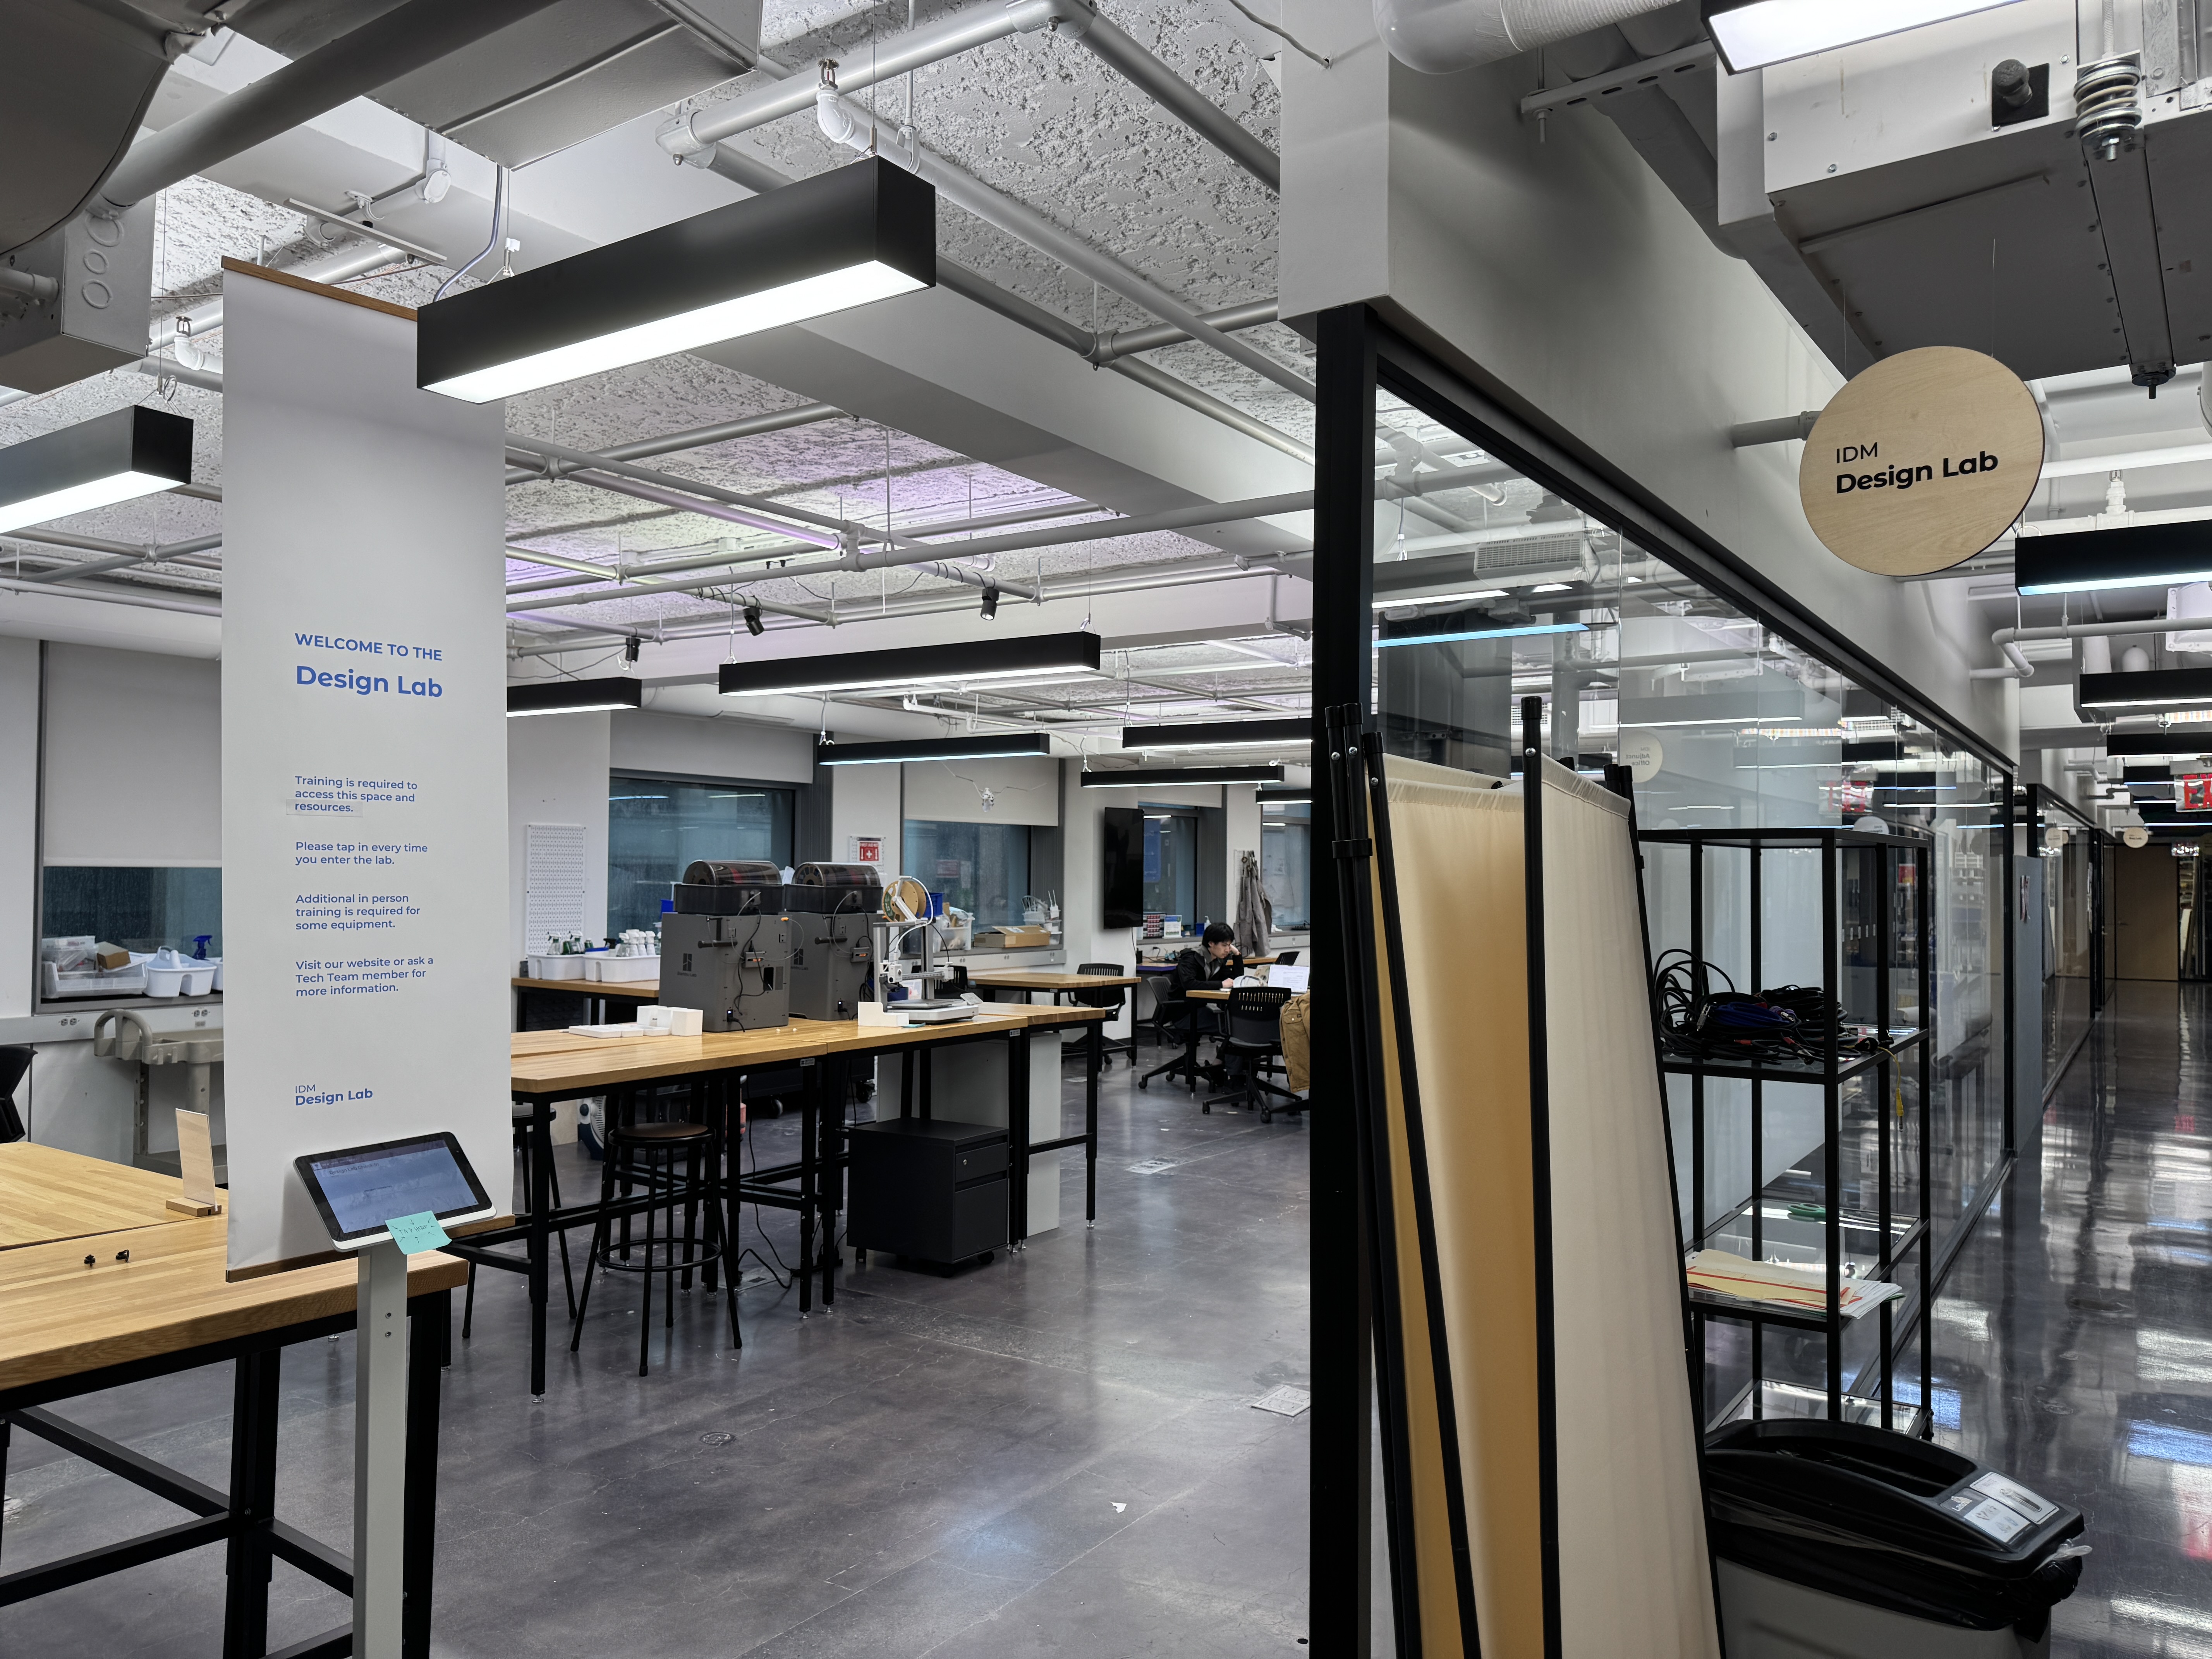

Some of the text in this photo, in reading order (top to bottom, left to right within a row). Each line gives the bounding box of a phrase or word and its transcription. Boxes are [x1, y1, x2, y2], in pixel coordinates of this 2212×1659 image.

[1836, 442, 1877, 464] IDM
[1836, 451, 1998, 494] Design Lab
[295, 633, 442, 661] WELCOME TO THE
[297, 665, 443, 697] Design Lab
[295, 776, 417, 790] Training is required to
[295, 791, 415, 802] access this space and
[295, 803, 353, 812] resources.
[296, 842, 428, 854] Please tap in every time
[295, 857, 317, 866] you
[353, 855, 372, 864] the
[375, 855, 394, 865] lab.
[296, 894, 409, 905] Additional in person
[295, 906, 420, 918] training is required for
[331, 920, 395, 931] equipment.
[296, 960, 321, 970] Visit
[347, 958, 391, 968] website
[408, 957, 424, 965] ask
[296, 969, 426, 983] Tech Team member for
[330, 983, 398, 995] information.
[295, 1084, 316, 1093] IDM
[295, 1088, 373, 1106] Design Lab
